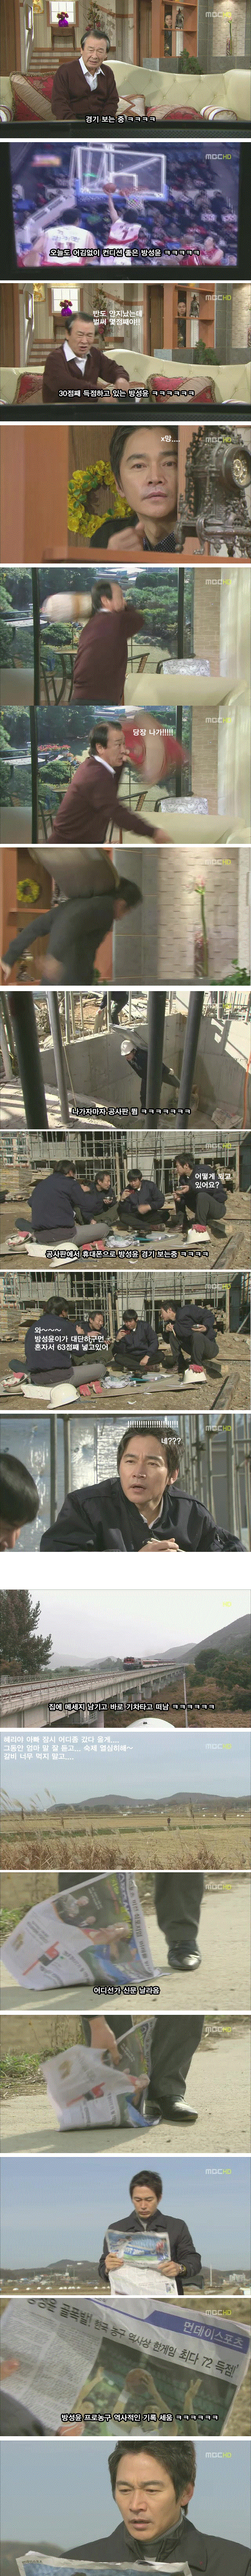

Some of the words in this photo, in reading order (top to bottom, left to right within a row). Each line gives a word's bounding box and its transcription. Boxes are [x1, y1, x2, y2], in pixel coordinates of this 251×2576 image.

[94, 2319, 109, 2333] 한국
[110, 2326, 126, 2338] 농구
[128, 2333, 152, 2349] 역사상
[153, 2341, 177, 2357] 한게임
[179, 2349, 199, 2365] 최다
[202, 2356, 213, 2369] 72
[182, 2321, 244, 2349] 먼데이스포츠
